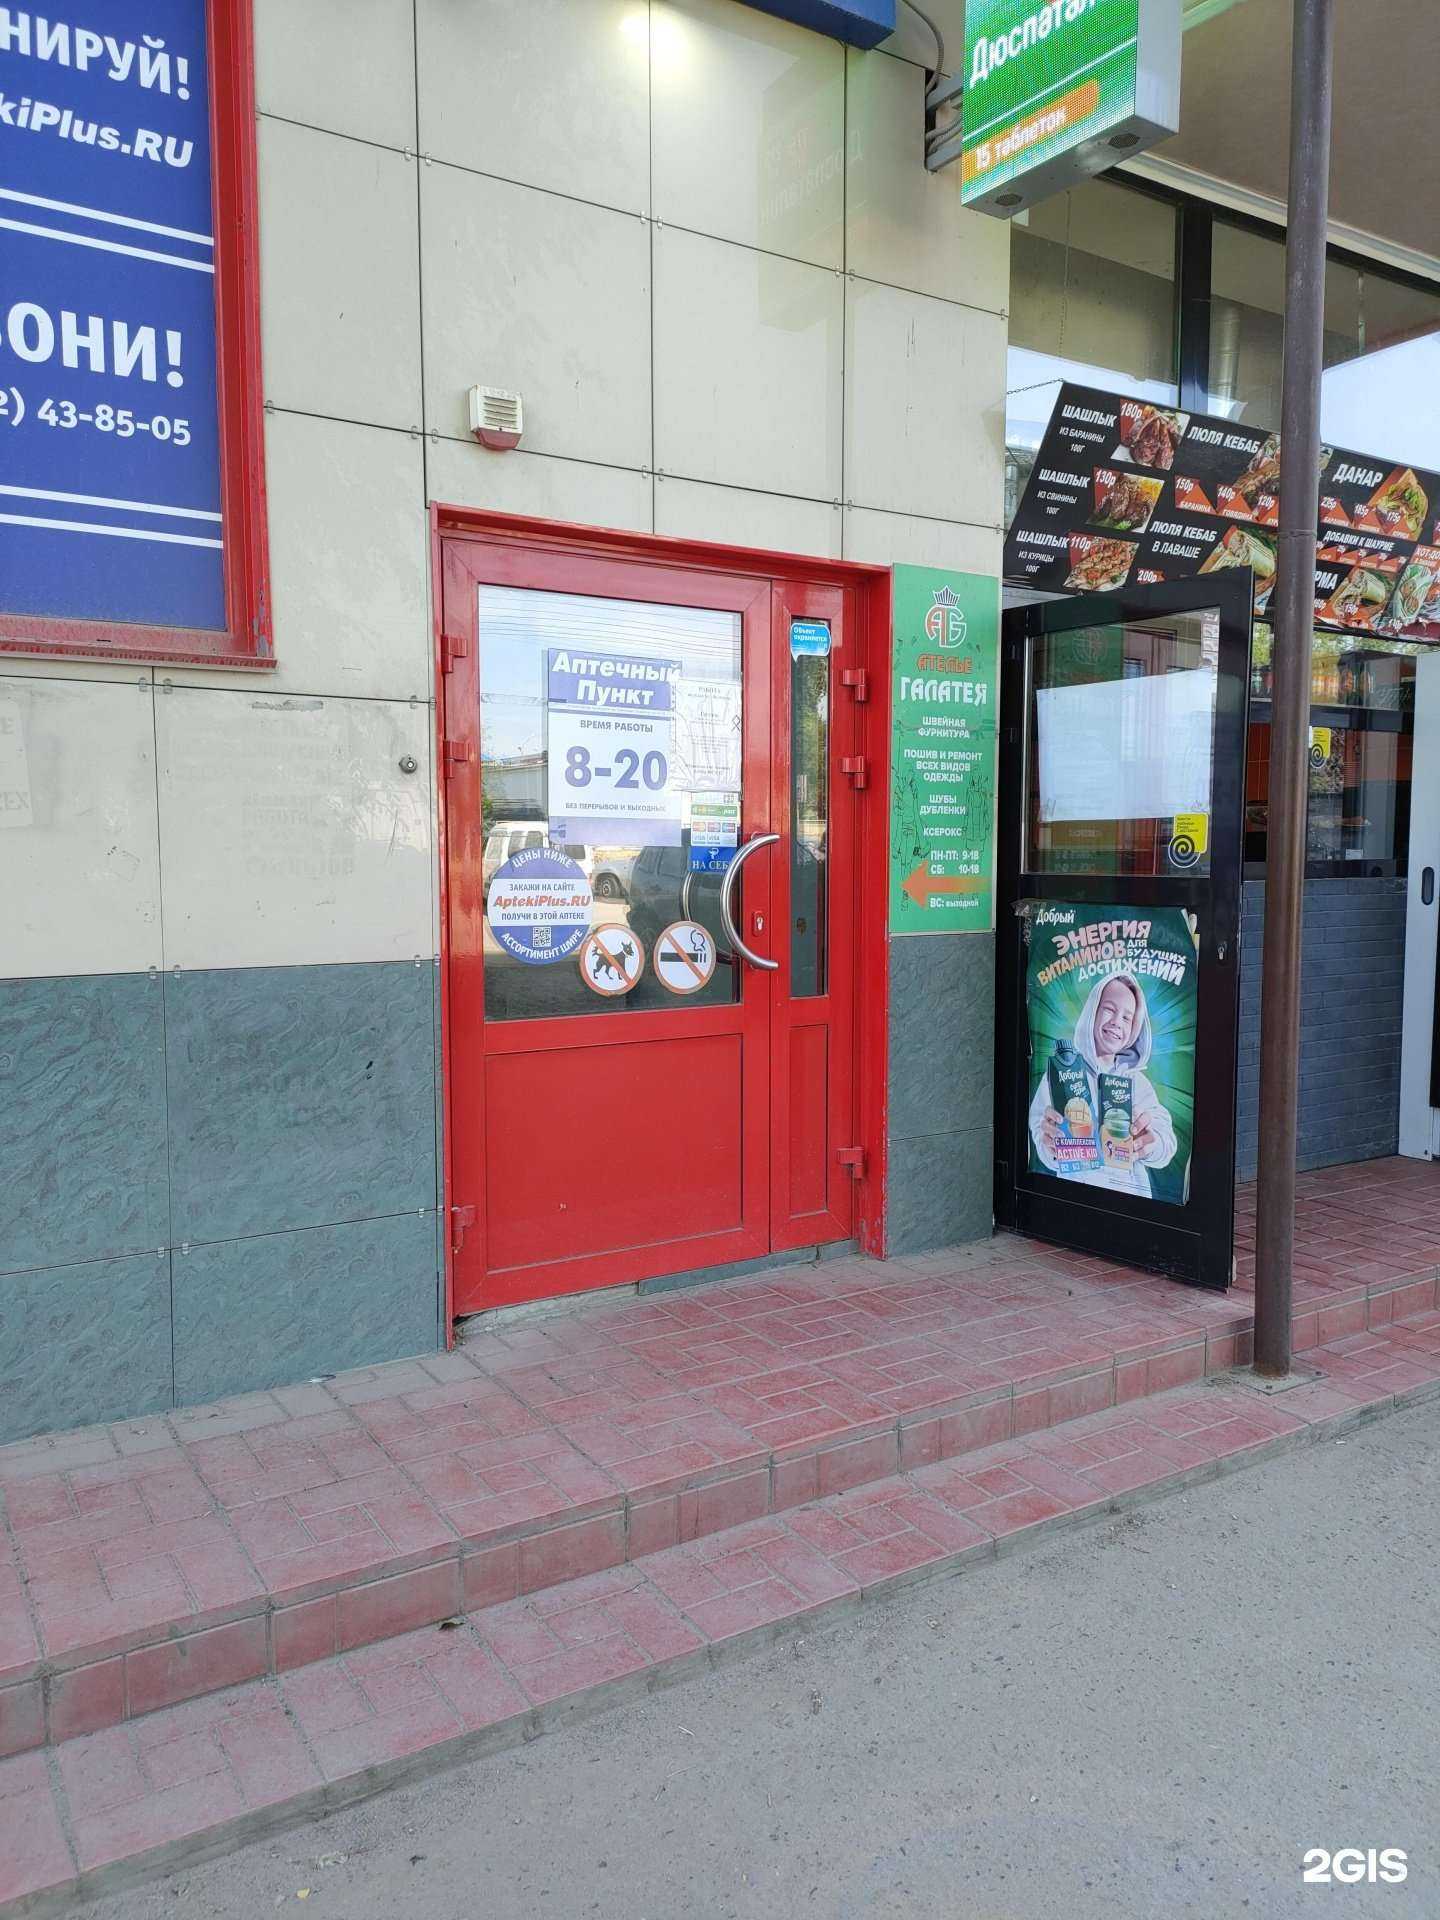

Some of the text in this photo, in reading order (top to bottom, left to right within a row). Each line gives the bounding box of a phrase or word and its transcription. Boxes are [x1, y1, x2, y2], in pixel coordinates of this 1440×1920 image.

[0, 92, 194, 168] kiPlus.RU
[0, 302, 184, 388] ОНИ!
[1061, 404, 1118, 428] ШАШЛЫК
[1120, 402, 1143, 420] 180р
[37, 398, 191, 446] 43-85-05
[1059, 427, 1105, 444] ИЗ БАРАНИНЫ
[1187, 426, 1261, 454] ЛЮЛЯ КЕБАБ
[1038, 468, 1092, 489] ШАШЛЫК
[1095, 469, 1117, 487] 130р
[1332, 463, 1384, 488] ДАНАР
[1175, 478, 1194, 494] 150р
[1217, 486, 1236, 502] 140р
[1037, 490, 1078, 505] ИЗ СВИНИНЫ
[1257, 494, 1275, 510] 120р
[1015, 530, 1070, 549] ШАШЛЫК
[1150, 521, 1218, 543] ЛЮЛЯ КЕБАБ
[1323, 530, 1359, 546] ДОБАВКИ
[1358, 537, 1364, 548] К
[1070, 535, 1092, 552] 110р
[1152, 541, 1202, 559] В ЛАВАШЕ
[1018, 550, 1055, 563] ИЗ КУРИЦЫ
[1137, 569, 1157, 583] 200р
[1314, 570, 1338, 590] РМА
[552, 651, 682, 683] Аптечный
[917, 653, 974, 674] АТЕЛЬЕ
[576, 679, 654, 706] Пункт
[900, 676, 988, 706] ГАЛАТЕЯ
[580, 719, 654, 733] ВРЕМЯ РАБОТЫ
[922, 715, 967, 727] ШВЕЙНАЯ
[918, 727, 970, 739] ФУРНИТУРА
[904, 749, 983, 761] ПОШИВ И РЕМОНТ
[564, 745, 668, 790] 8-20
[916, 760, 971, 772] ВСЕХ ВИДОВ
[923, 773, 964, 783] ОДЕЖДЫ
[565, 802, 578, 810] БЕЗ
[579, 803, 619, 811] ПЕРЕРЫВОВ
[929, 794, 957, 804] ШУБЫ
[919, 805, 967, 815] ДУБЛЕНКИ
[923, 827, 963, 837] КСЕРОКС
[512, 849, 573, 869] ЦЕНЫ НИЖЕ
[930, 850, 959, 861] ПН-ПТ:
[692, 860, 731, 870] НА СЕБ
[930, 864, 980, 875] СБ: 10-18
[509, 880, 576, 892] ЗАКАЖИ НА САЙТЕ
[493, 895, 591, 910] AptekiPlus.RU
[930, 898, 945, 908] ВС:
[501, 910, 585, 921] ПОЛУЧИ В ЭТОЙ АПТЕКЕ
[1036, 908, 1076, 927] Добрый
[502, 928, 584, 960] АССОРТИМЕНТ ШИРЕ
[1051, 920, 1151, 955] ЭНЕРГИЯ
[1127, 939, 1148, 949] ДЛЯ
[1037, 939, 1127, 987] ВИТАМИНОВ
[1127, 949, 1187, 965] БУДУЩИХ
[1078, 958, 1186, 987] ДОСТИЖЕНИЙ
[1105, 1077, 1129, 1089] Добрый
[1057, 1148, 1086, 1160] ACTIVE
